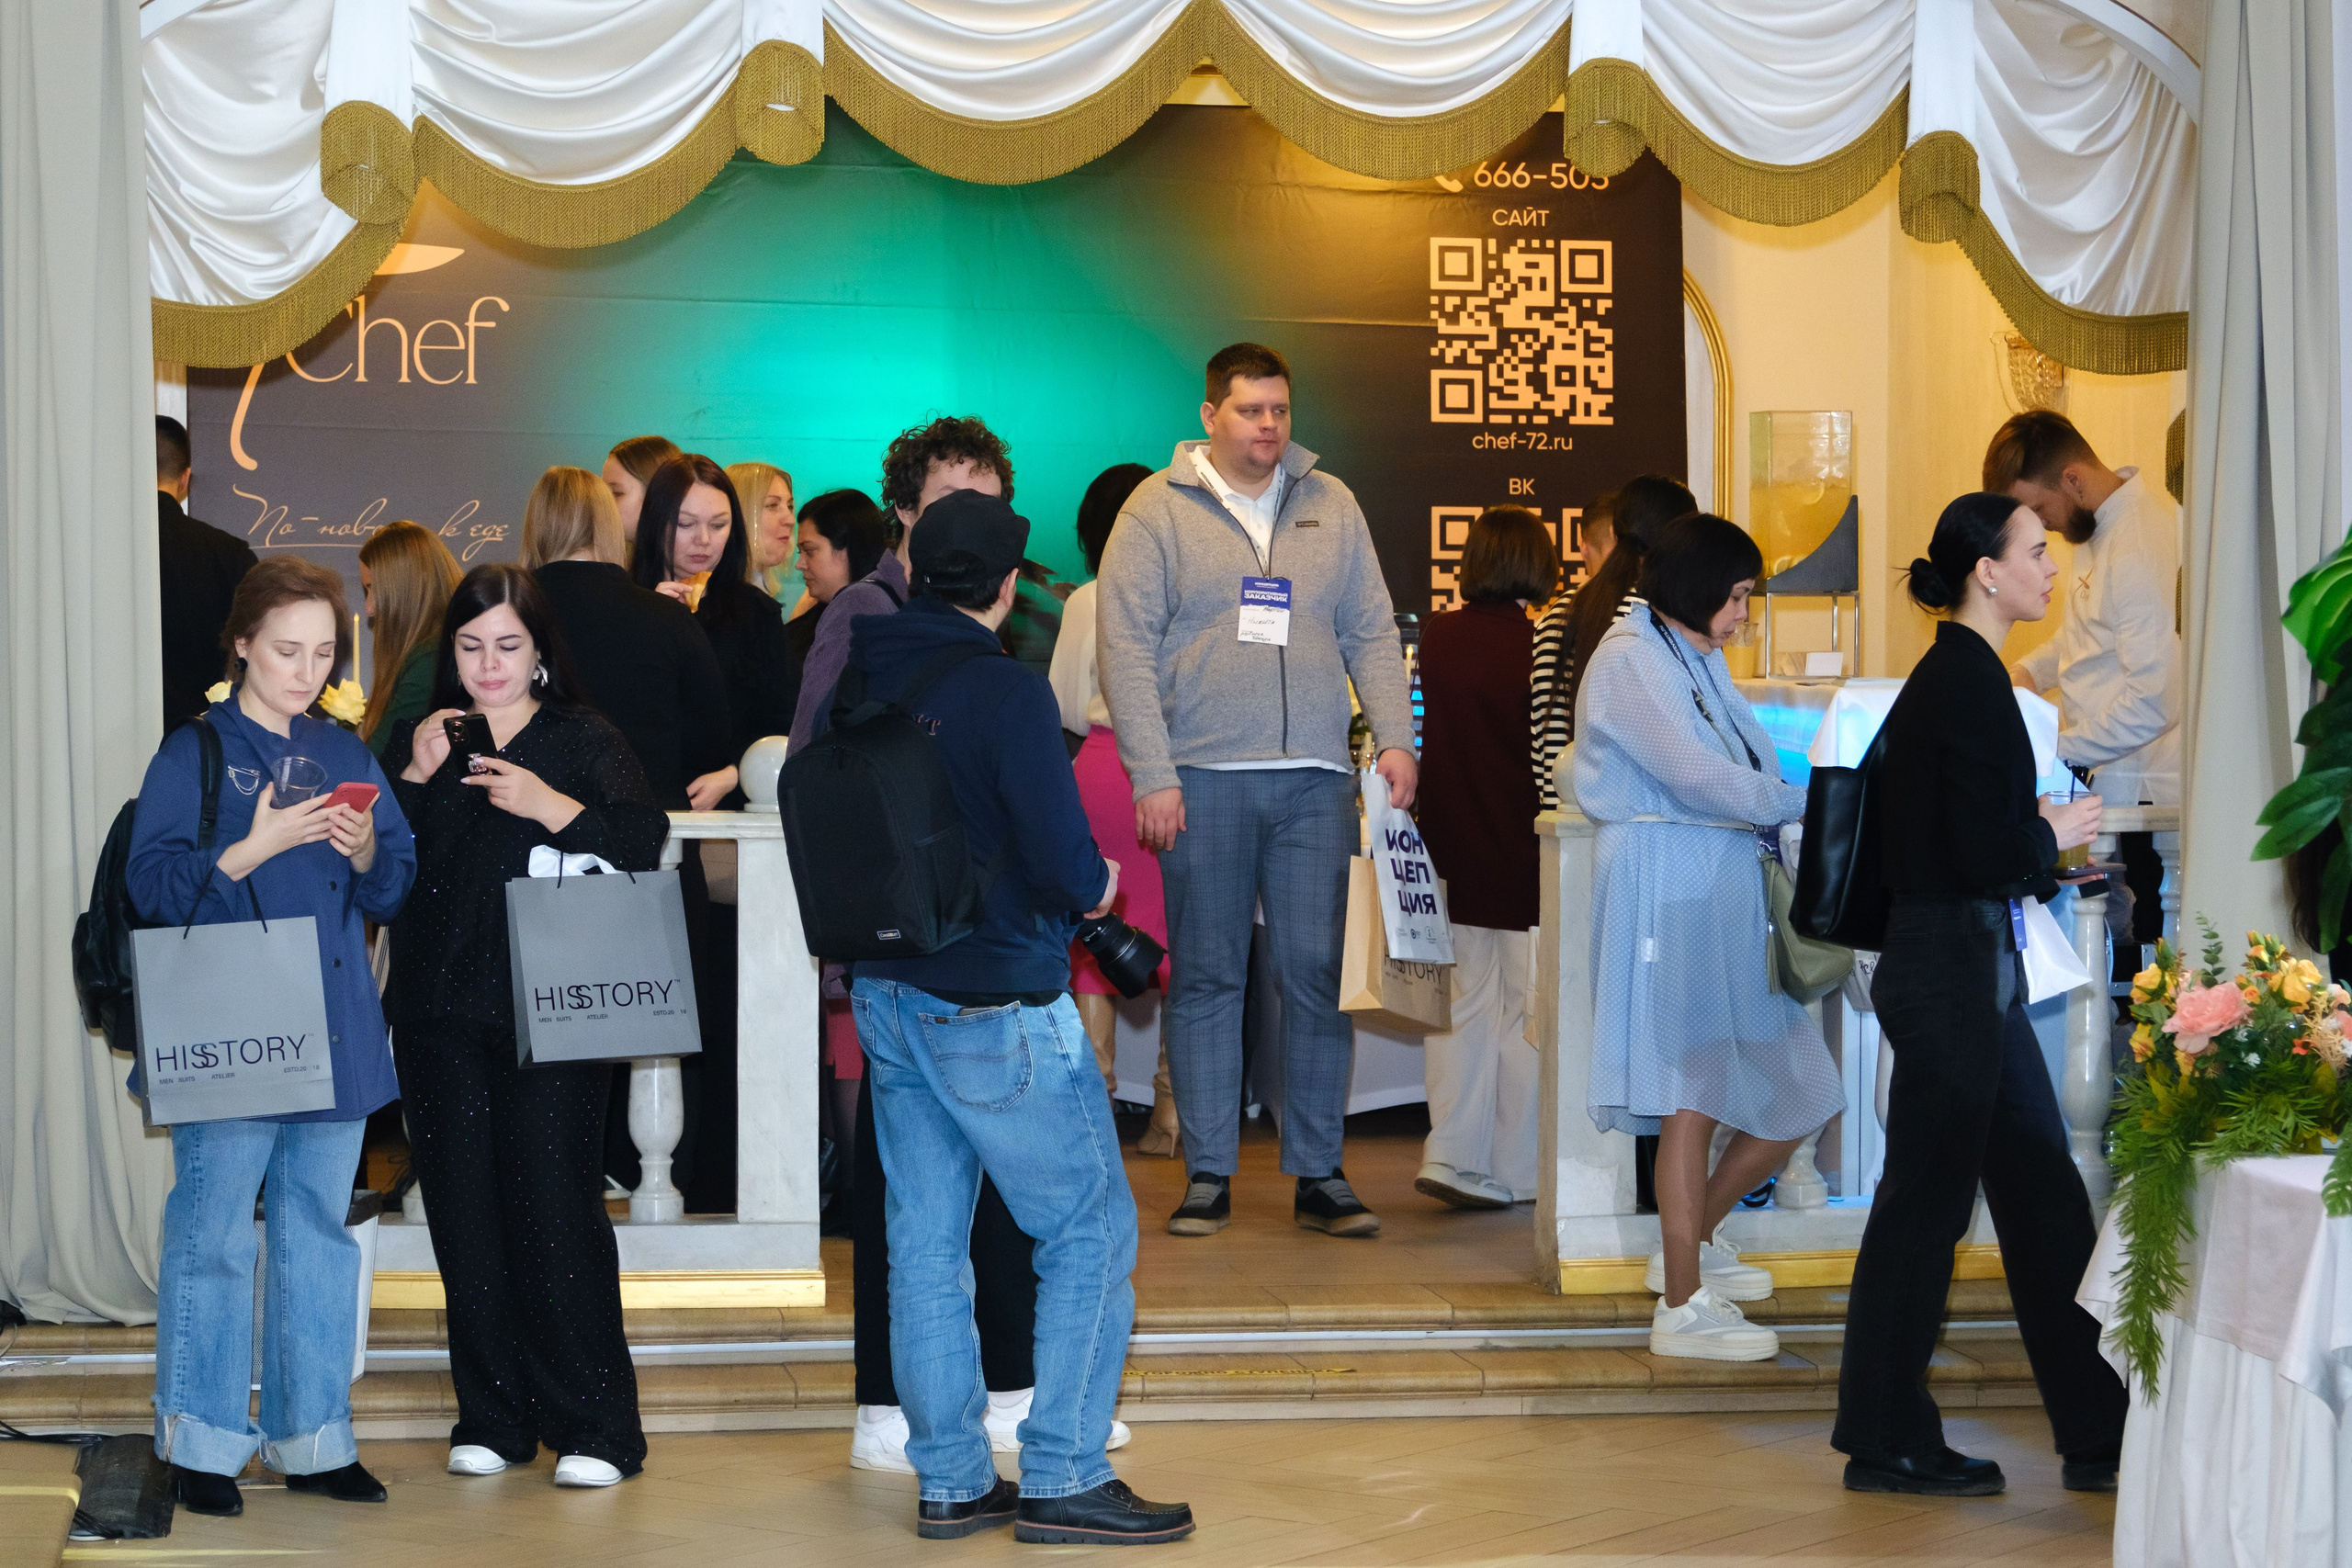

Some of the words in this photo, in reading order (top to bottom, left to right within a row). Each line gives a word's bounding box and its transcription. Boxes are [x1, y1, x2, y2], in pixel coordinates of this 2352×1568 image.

[1491, 206, 1550, 228] САЙТ
[1471, 431, 1574, 451] chef-72.ru
[1508, 478, 1536, 496] ВК
[1244, 592, 1288, 603] ЗАКАЗЧИК
[1390, 857, 1431, 886] ЦЕП
[1397, 889, 1438, 918] ЦИЯ
[534, 979, 673, 1012] HISSTORY
[155, 1033, 307, 1073] HISSTORY
